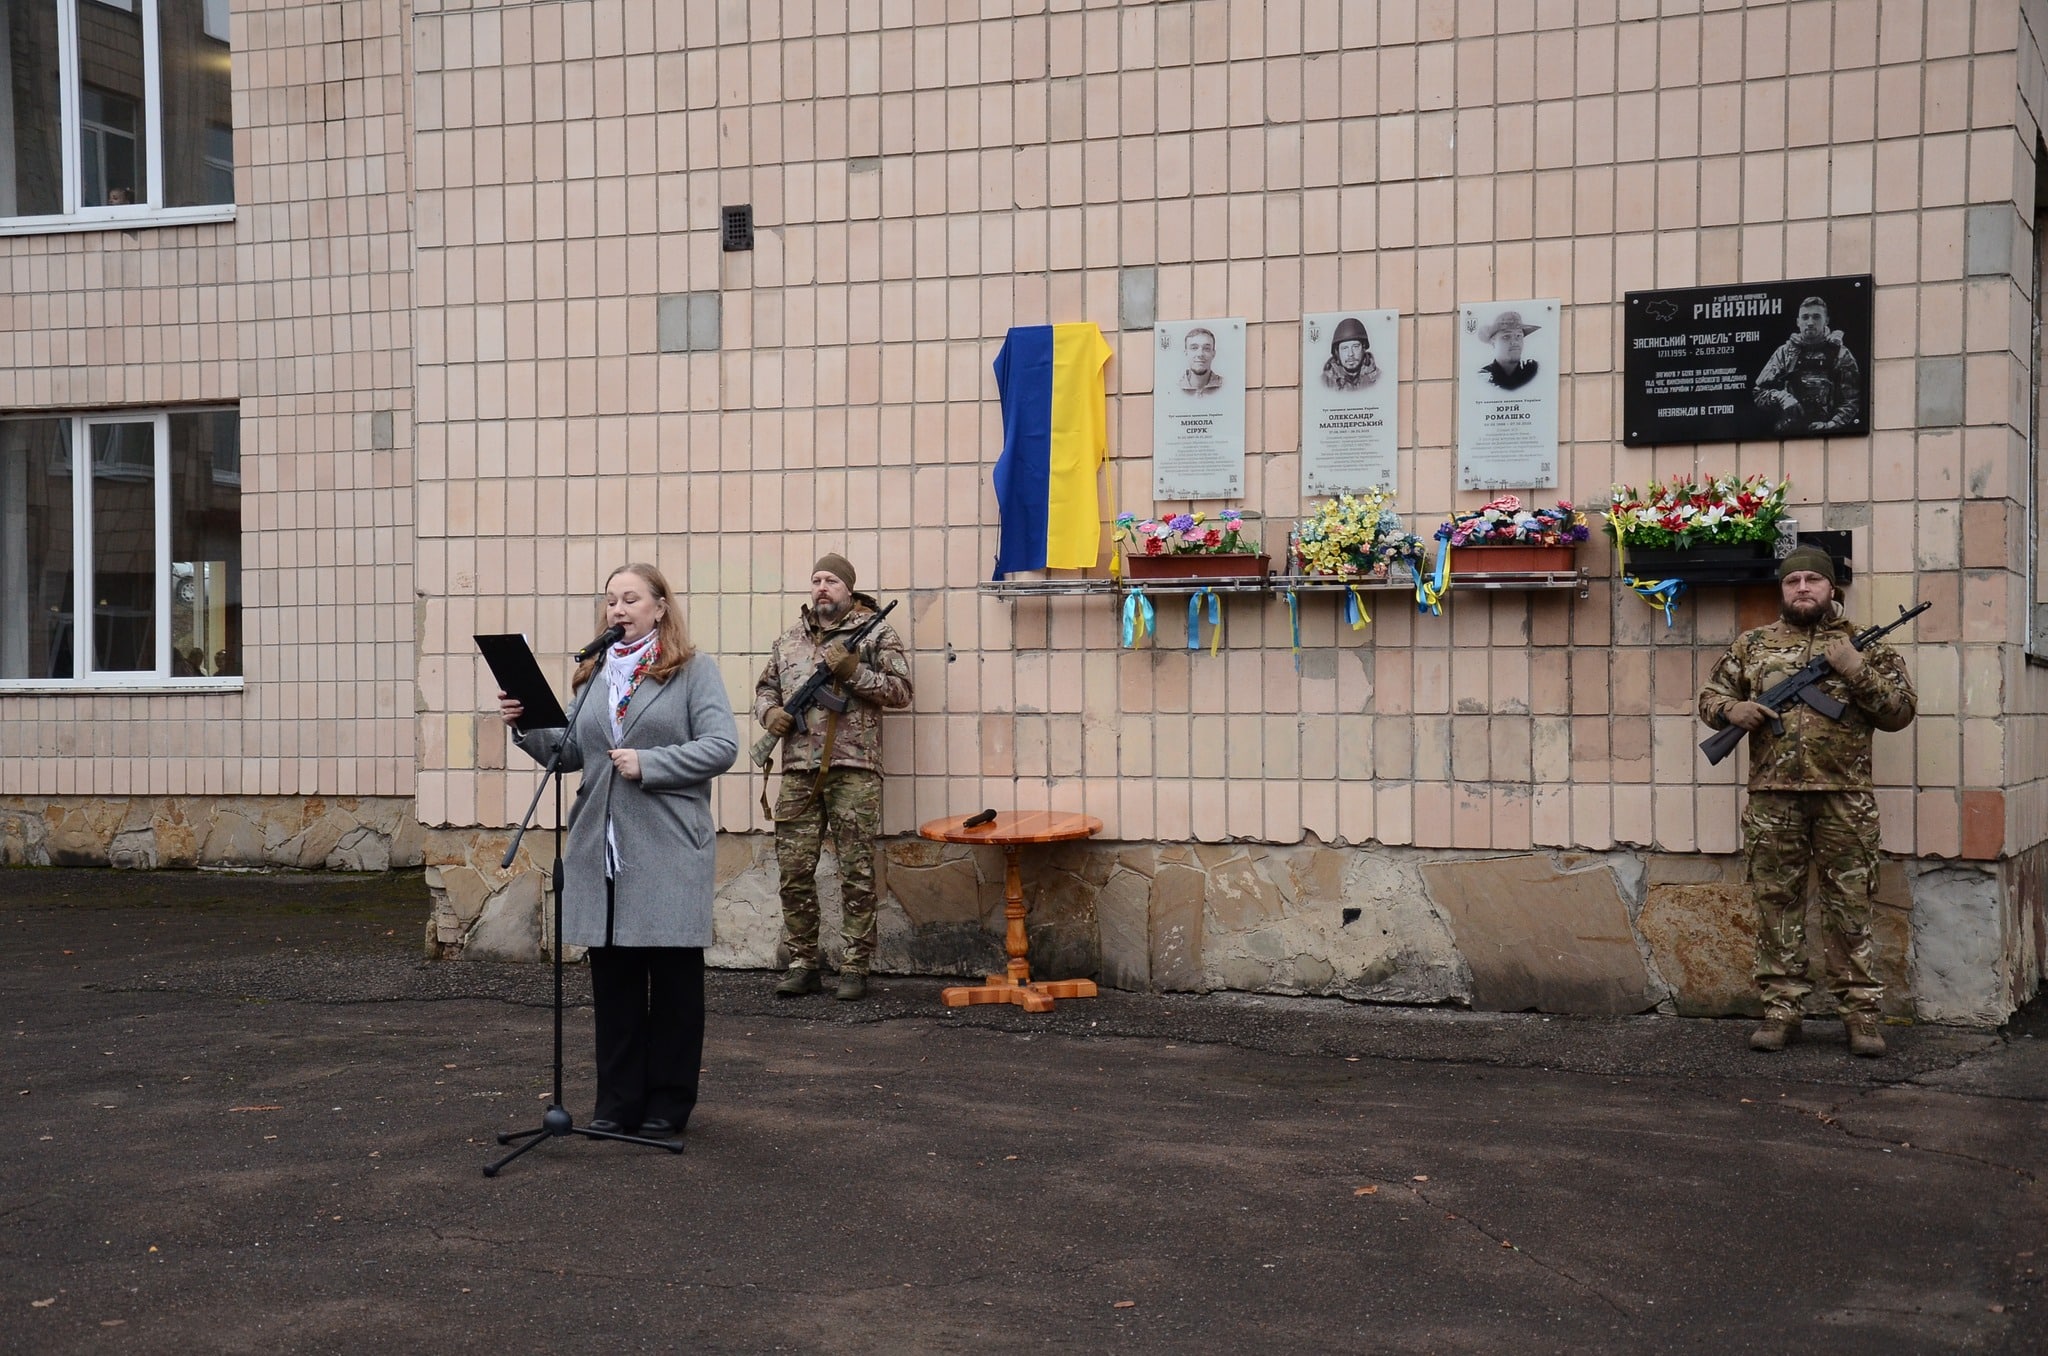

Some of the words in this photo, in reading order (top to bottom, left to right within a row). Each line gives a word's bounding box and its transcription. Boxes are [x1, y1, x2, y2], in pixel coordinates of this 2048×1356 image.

[1693, 298, 1782, 320] РІВНЯНИН
[1633, 334, 1686, 349] ЗАСАНСЬКИЙ
[1689, 332, 1732, 346] "РОМЕЛЬ"
[1735, 331, 1760, 343] ЕРВІН
[1695, 346, 1735, 356] 26.09.2023
[1496, 403, 1520, 412] ЮРІЙ
[1657, 406, 1698, 418] НАЗАВЖДИ
[1700, 406, 1705, 416] В
[1708, 404, 1735, 415] СТРОЮ
[1328, 413, 1374, 421] ОЛЕКСАНДР
[1485, 413, 1531, 421] РОМАШКО
